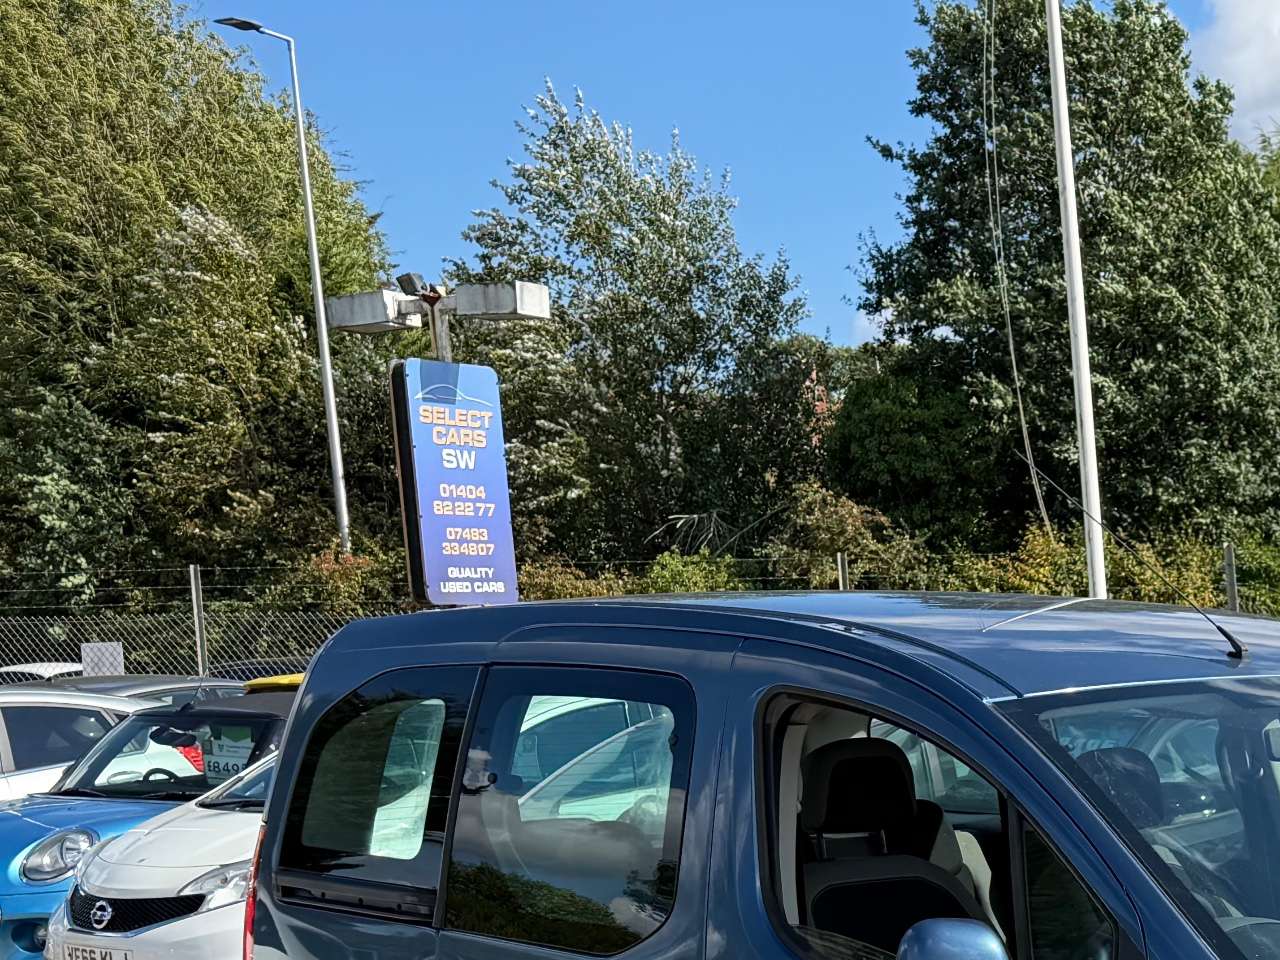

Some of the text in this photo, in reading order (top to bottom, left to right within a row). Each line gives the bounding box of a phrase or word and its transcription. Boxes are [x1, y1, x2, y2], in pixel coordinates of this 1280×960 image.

[419, 405, 493, 428] SELECT
[432, 426, 487, 448] CARS
[442, 448, 476, 470] SW
[439, 483, 486, 499] 01404
[447, 566, 494, 578] QUALITY
[440, 581, 505, 593] USED CARS
